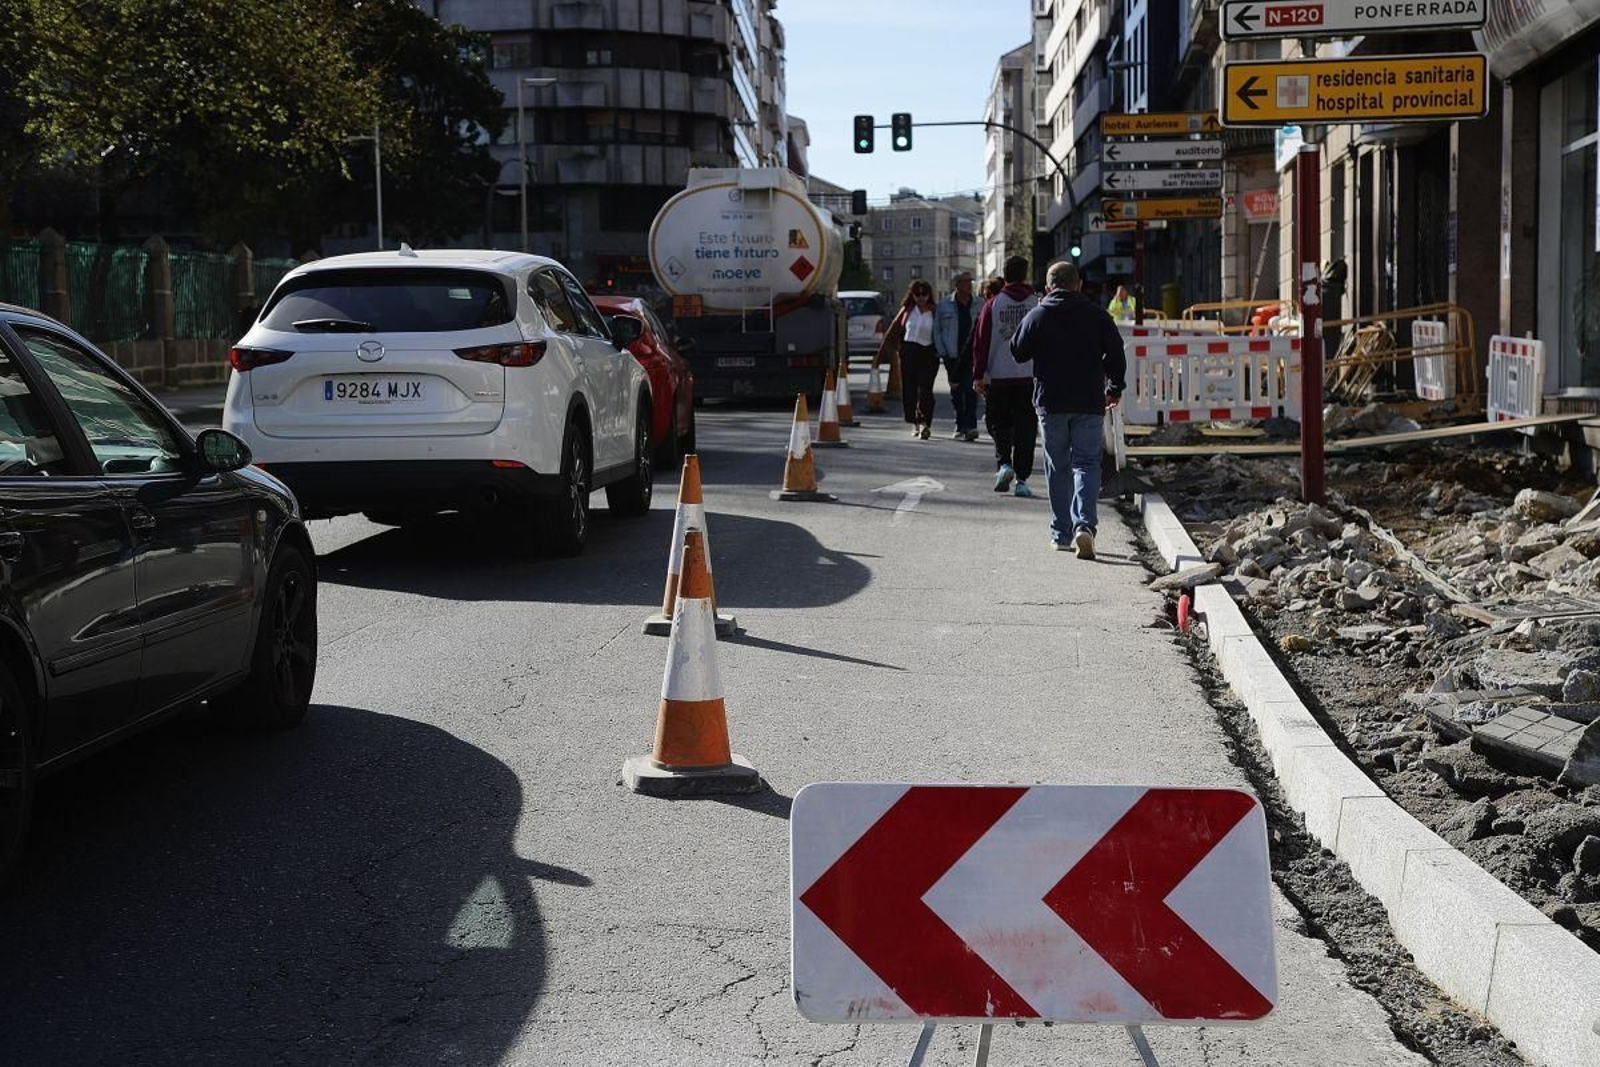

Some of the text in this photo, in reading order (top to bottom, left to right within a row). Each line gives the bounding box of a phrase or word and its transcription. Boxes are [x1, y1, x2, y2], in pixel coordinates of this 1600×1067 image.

[1268, 0, 1478, 24] N-120 PONFERRADA
[1316, 65, 1475, 87] residencia sanitaria
[1316, 90, 1475, 113] hospital provincial
[1104, 119, 1179, 130] hotel Auriense
[1175, 145, 1220, 156] auditorio
[699, 231, 728, 245] Este
[694, 245, 779, 259] tiene futuro
[712, 268, 762, 280] moeve
[336, 382, 422, 398] 9284 MJX
